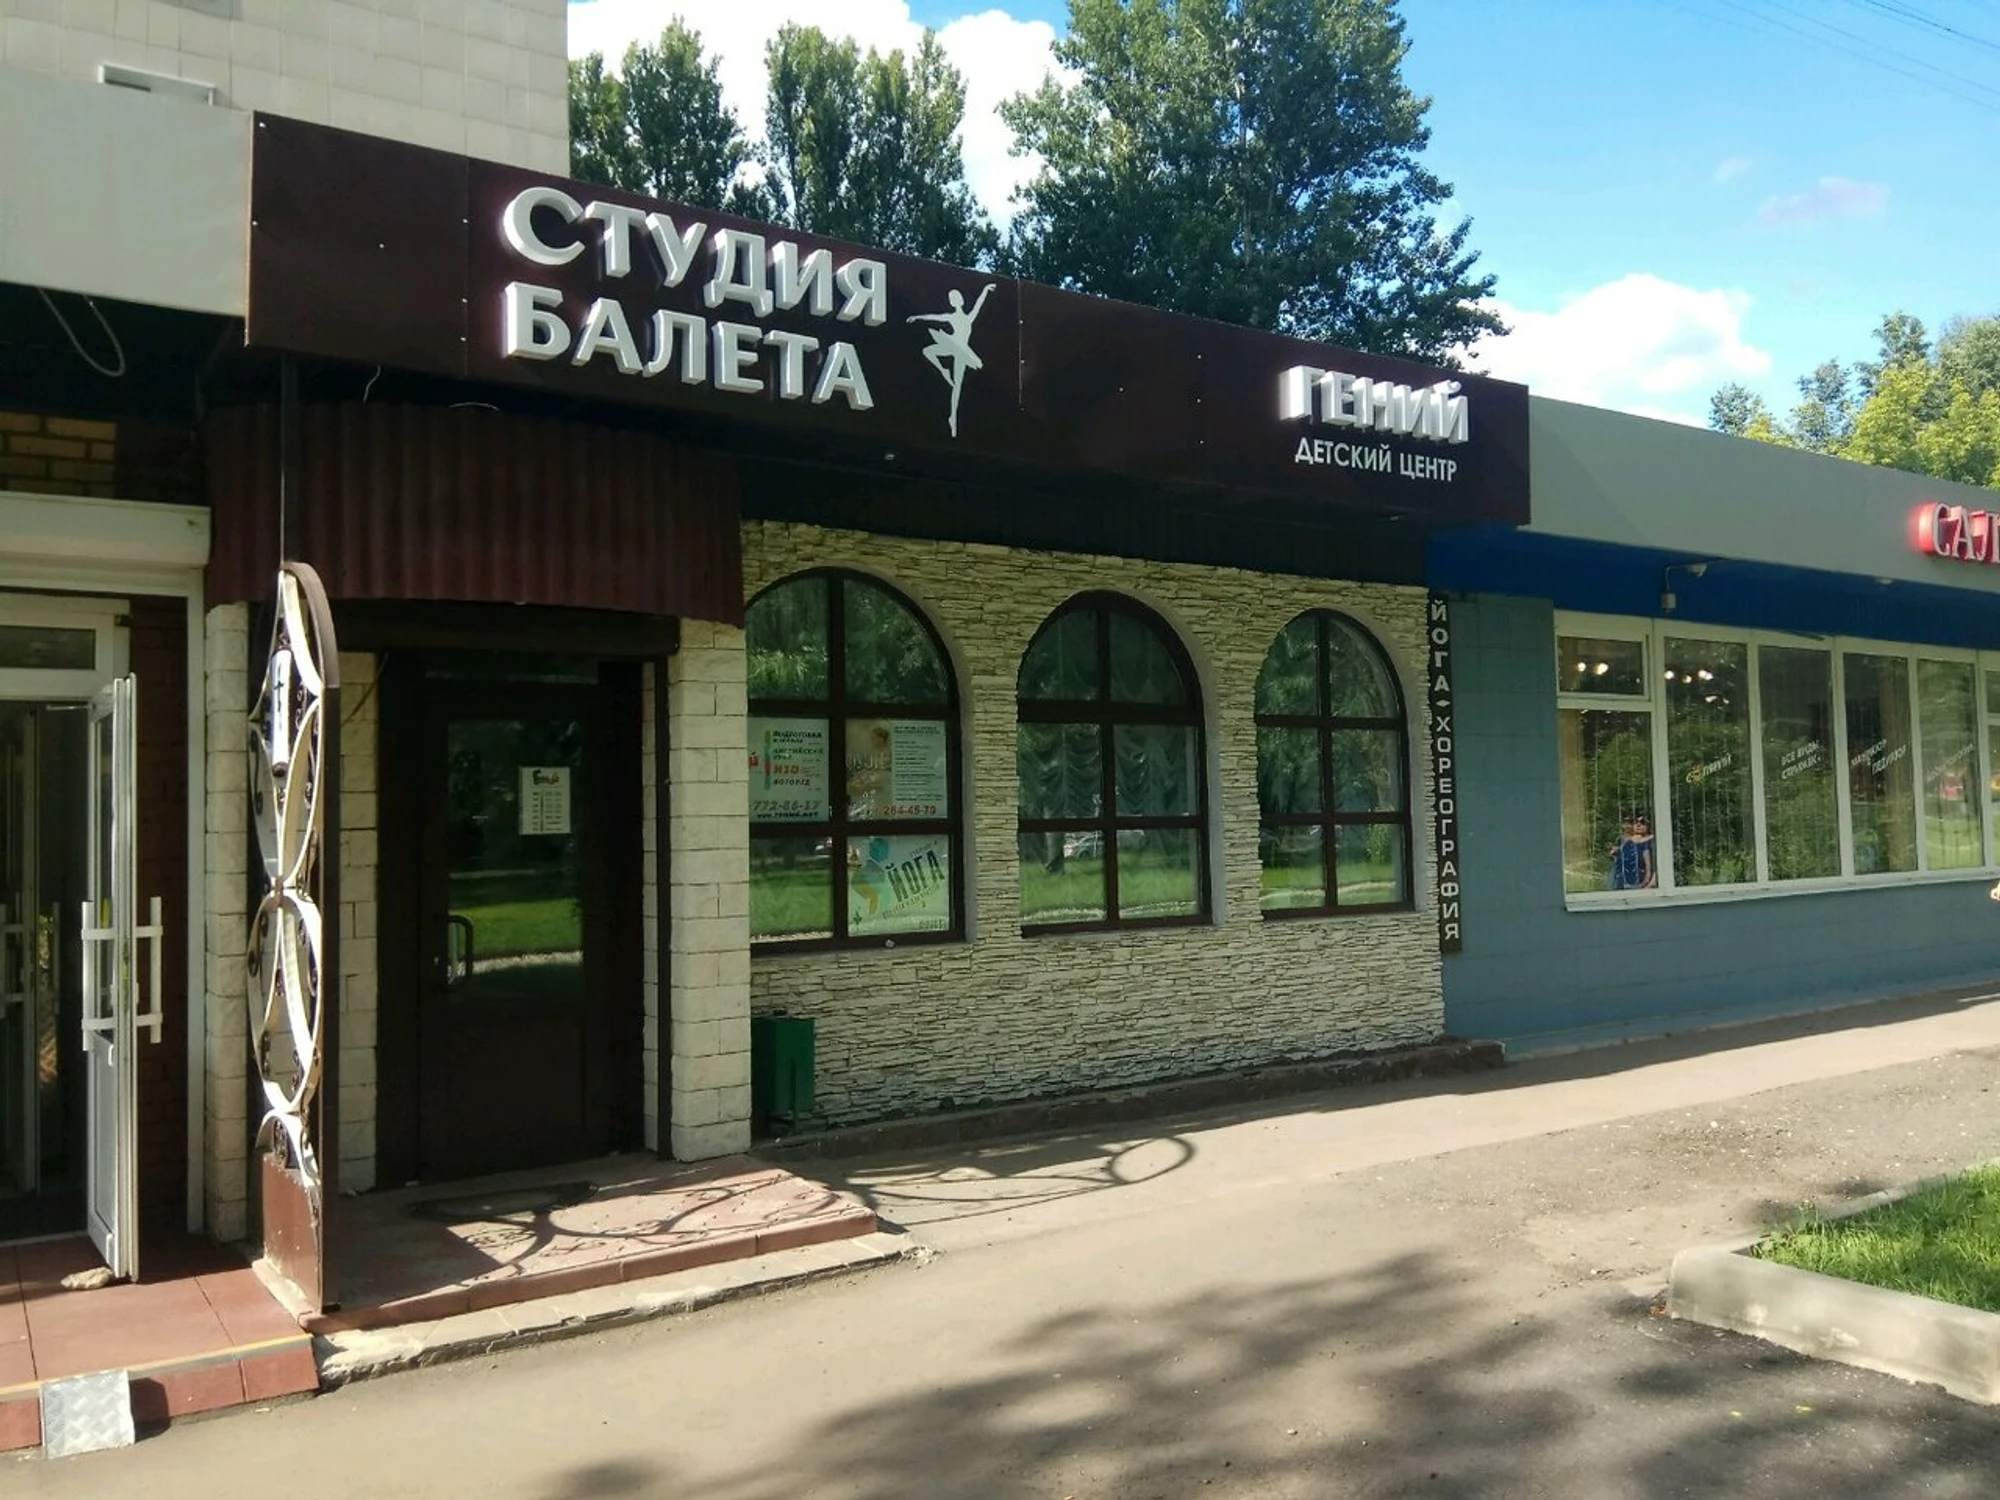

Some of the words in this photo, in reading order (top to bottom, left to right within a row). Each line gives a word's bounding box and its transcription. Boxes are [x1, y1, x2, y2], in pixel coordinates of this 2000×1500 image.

[504, 186, 888, 327] СТУДИЯ
[504, 282, 875, 411] БАЛЕТА
[1278, 365, 1469, 444] ГЕНИЙ
[1295, 437, 1392, 473] ДЕТСКИЙ
[1400, 452, 1457, 482] ЦЕНТР
[1431, 600, 1450, 692] ЙОГА
[1436, 716, 1461, 941] ХОРЕОГРАФИЯ
[885, 850, 945, 902] ЙОГА
